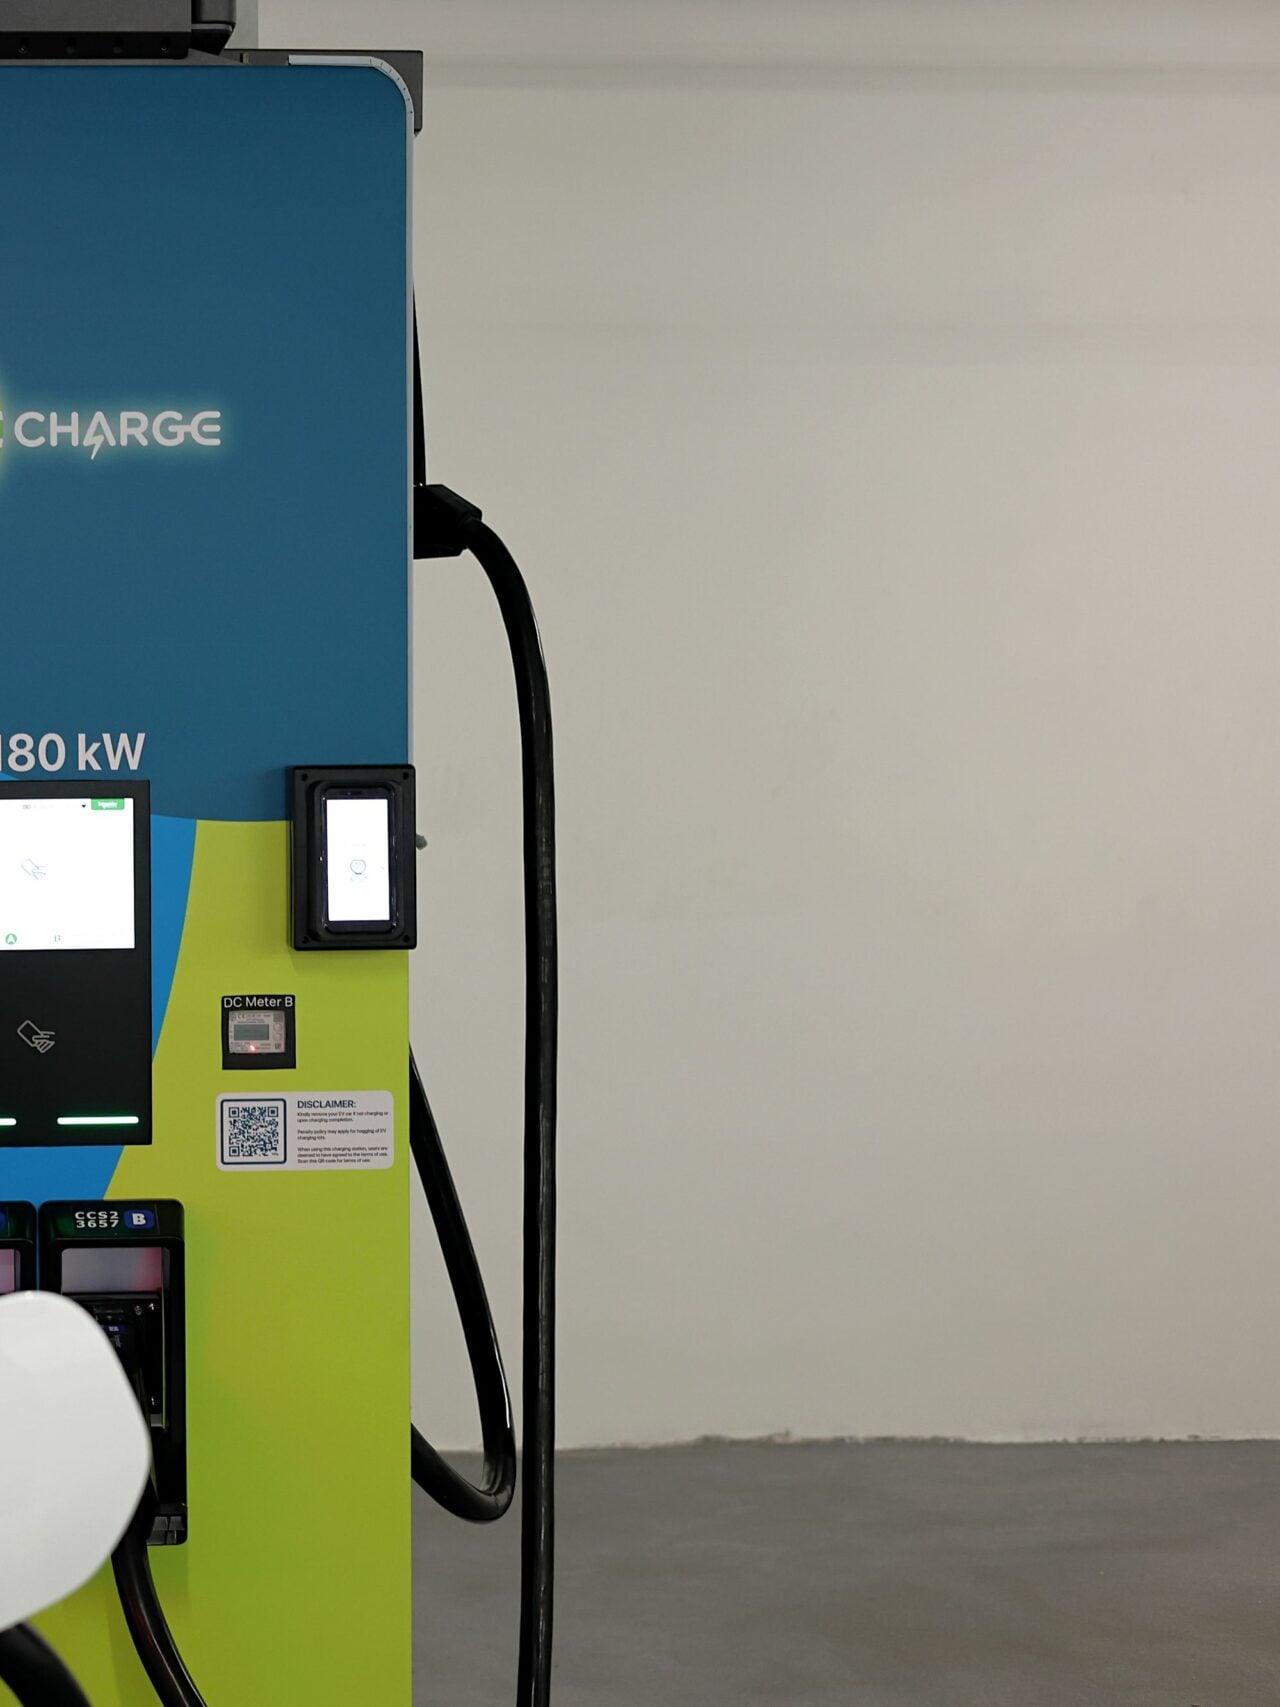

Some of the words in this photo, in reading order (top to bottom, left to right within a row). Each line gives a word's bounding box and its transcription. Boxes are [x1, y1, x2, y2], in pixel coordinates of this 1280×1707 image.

[14, 411, 221, 460] CHARGE
[78, 732, 146, 771] kW
[223, 997, 242, 1008] DC
[245, 996, 282, 1007] Meter
[285, 996, 293, 1007] B
[297, 1100, 357, 1109] DISCLAIMER:
[75, 1211, 119, 1220] CCS2
[132, 1213, 146, 1225] B
[76, 1220, 119, 1228] 3657
